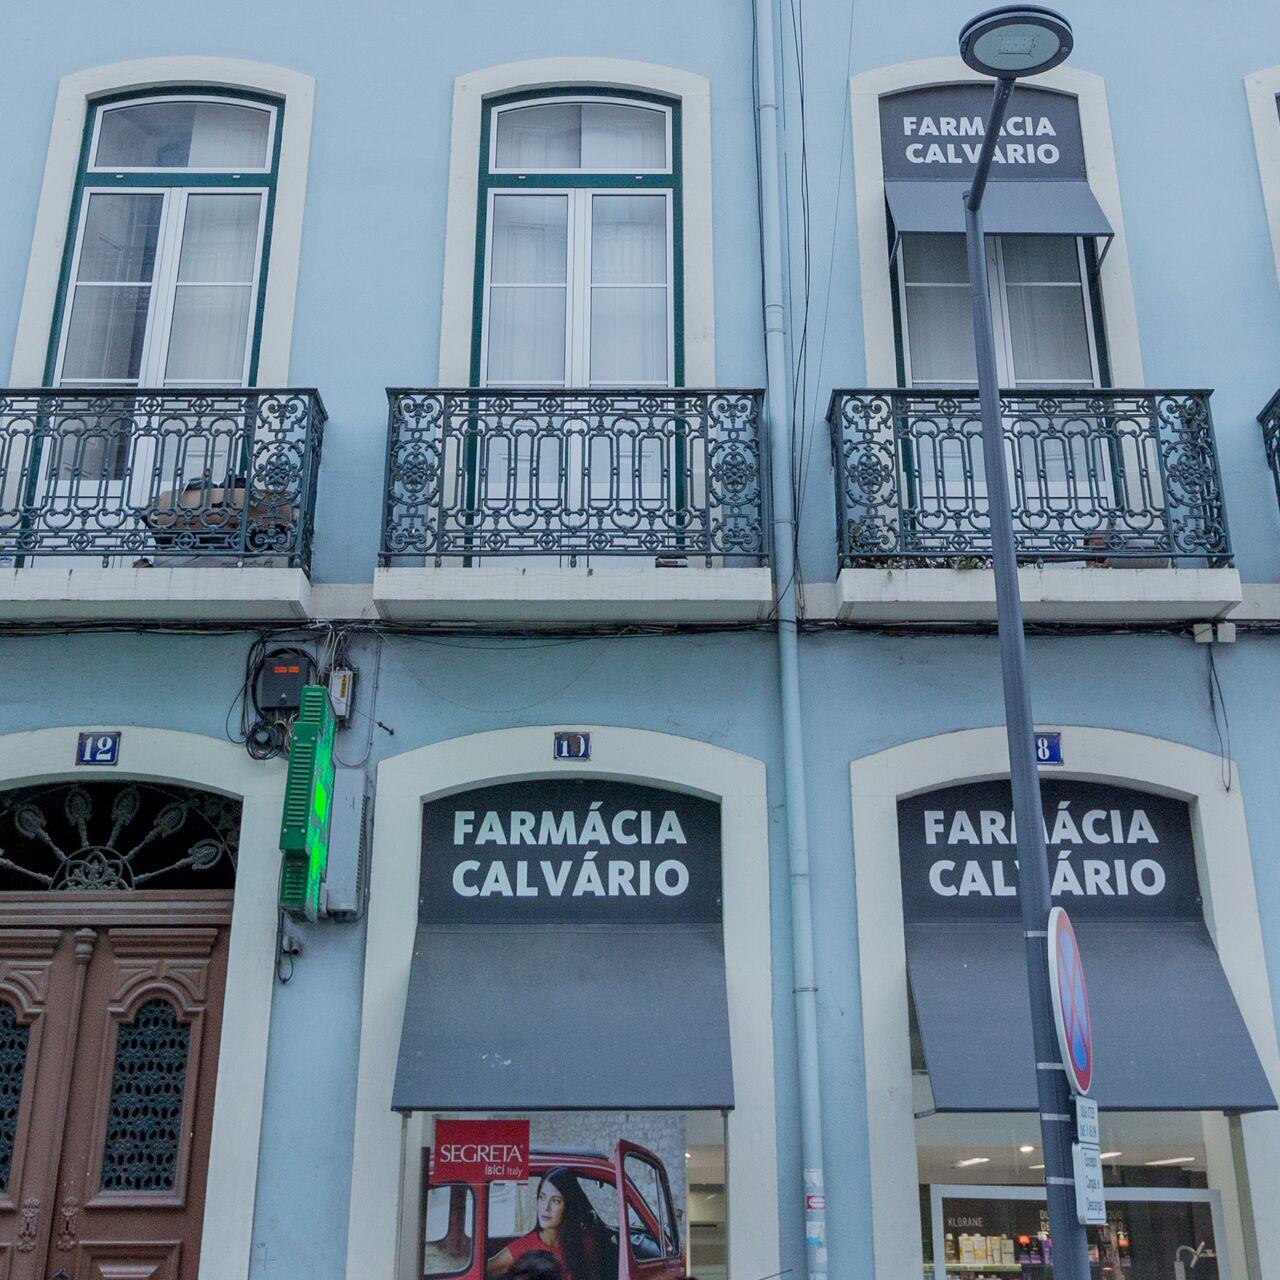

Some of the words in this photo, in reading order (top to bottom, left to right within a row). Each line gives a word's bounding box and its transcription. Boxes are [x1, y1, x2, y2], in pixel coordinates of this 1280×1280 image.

[902, 116, 1057, 137] FARMCIA
[82, 736, 113, 761] 12
[1037, 737, 1050, 760] 8
[453, 800, 688, 846] FARMÁCIA
[451, 850, 690, 898] CALVÁRIO
[928, 849, 1167, 897] CALÁRIO
[439, 1144, 523, 1163] SEGRETA
[947, 1215, 984, 1228] KLORANE
